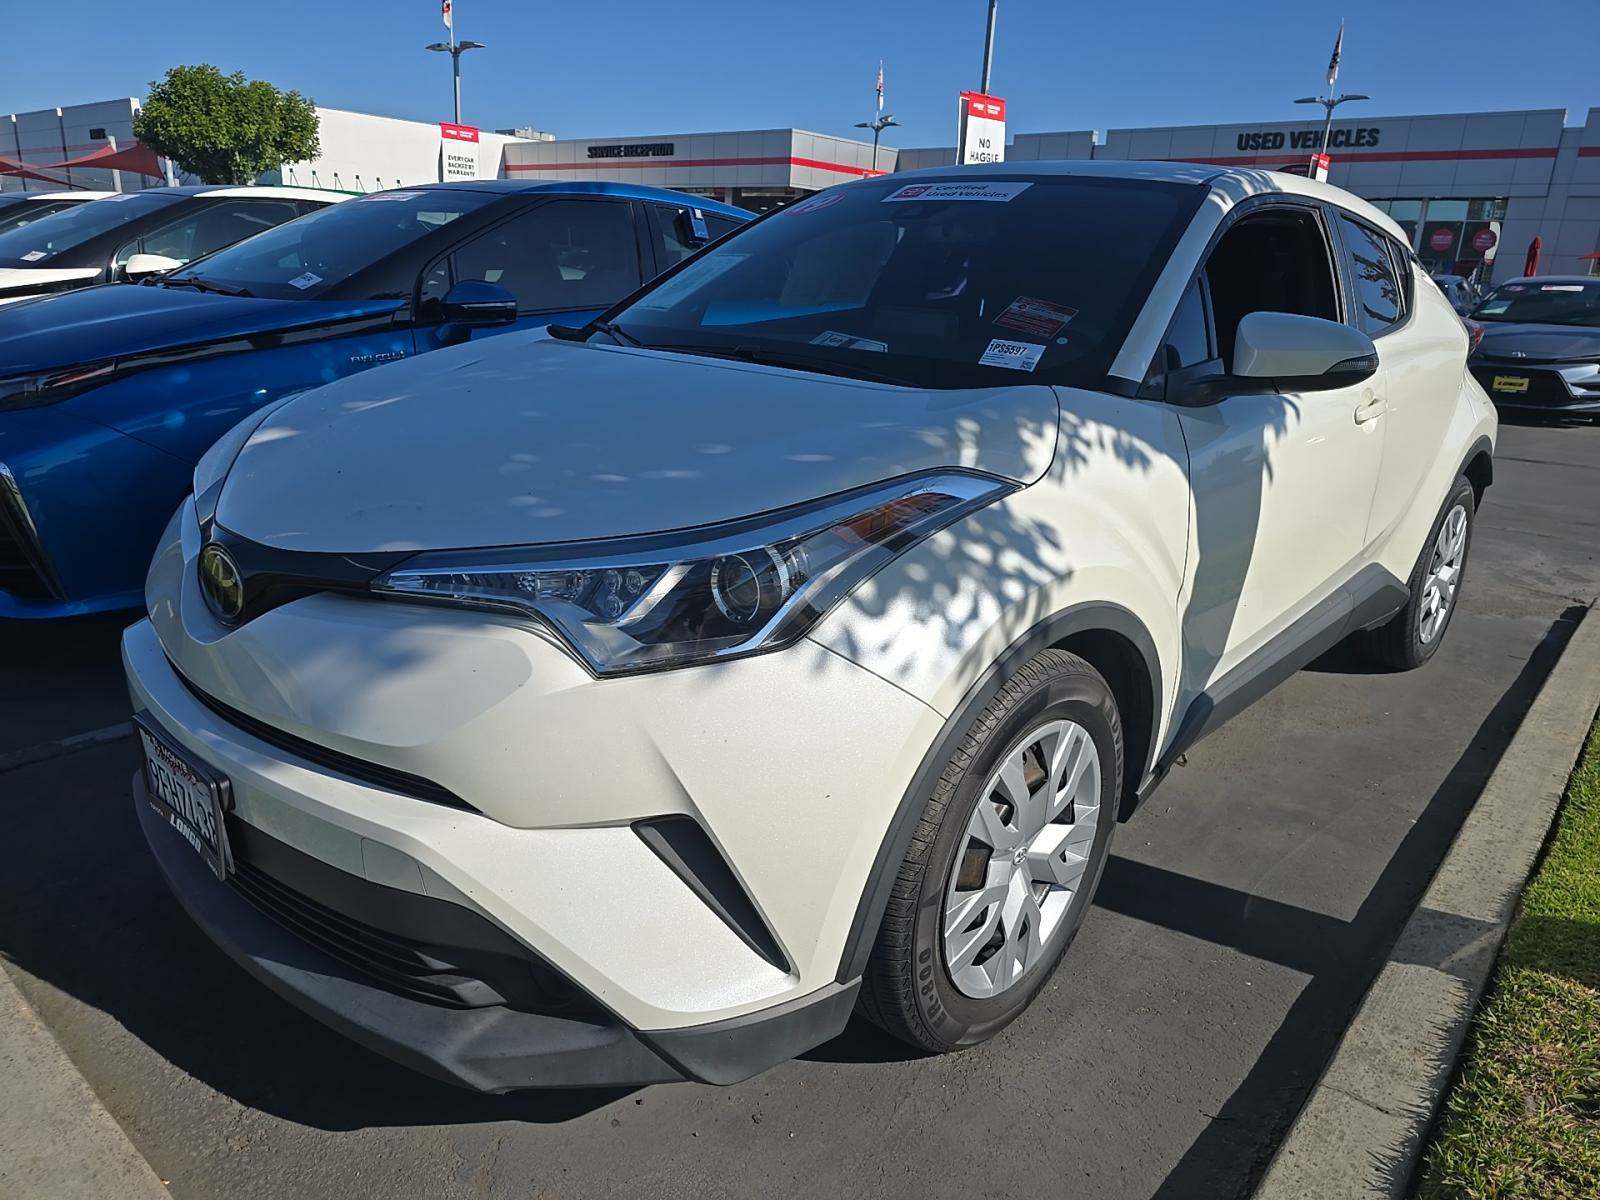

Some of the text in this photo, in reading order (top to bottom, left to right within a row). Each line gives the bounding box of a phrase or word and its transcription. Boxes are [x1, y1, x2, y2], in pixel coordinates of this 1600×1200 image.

[978, 137, 991, 149] NO
[1237, 128, 1380, 150] USED VEHICLES
[587, 143, 674, 158] SERVICE RECEPTION
[970, 151, 1000, 163] HAGGLE
[926, 190, 957, 198] Used
[958, 190, 1010, 199] Vehicles
[987, 343, 1028, 357] 1PS5597
[169, 813, 202, 854] LONGO
